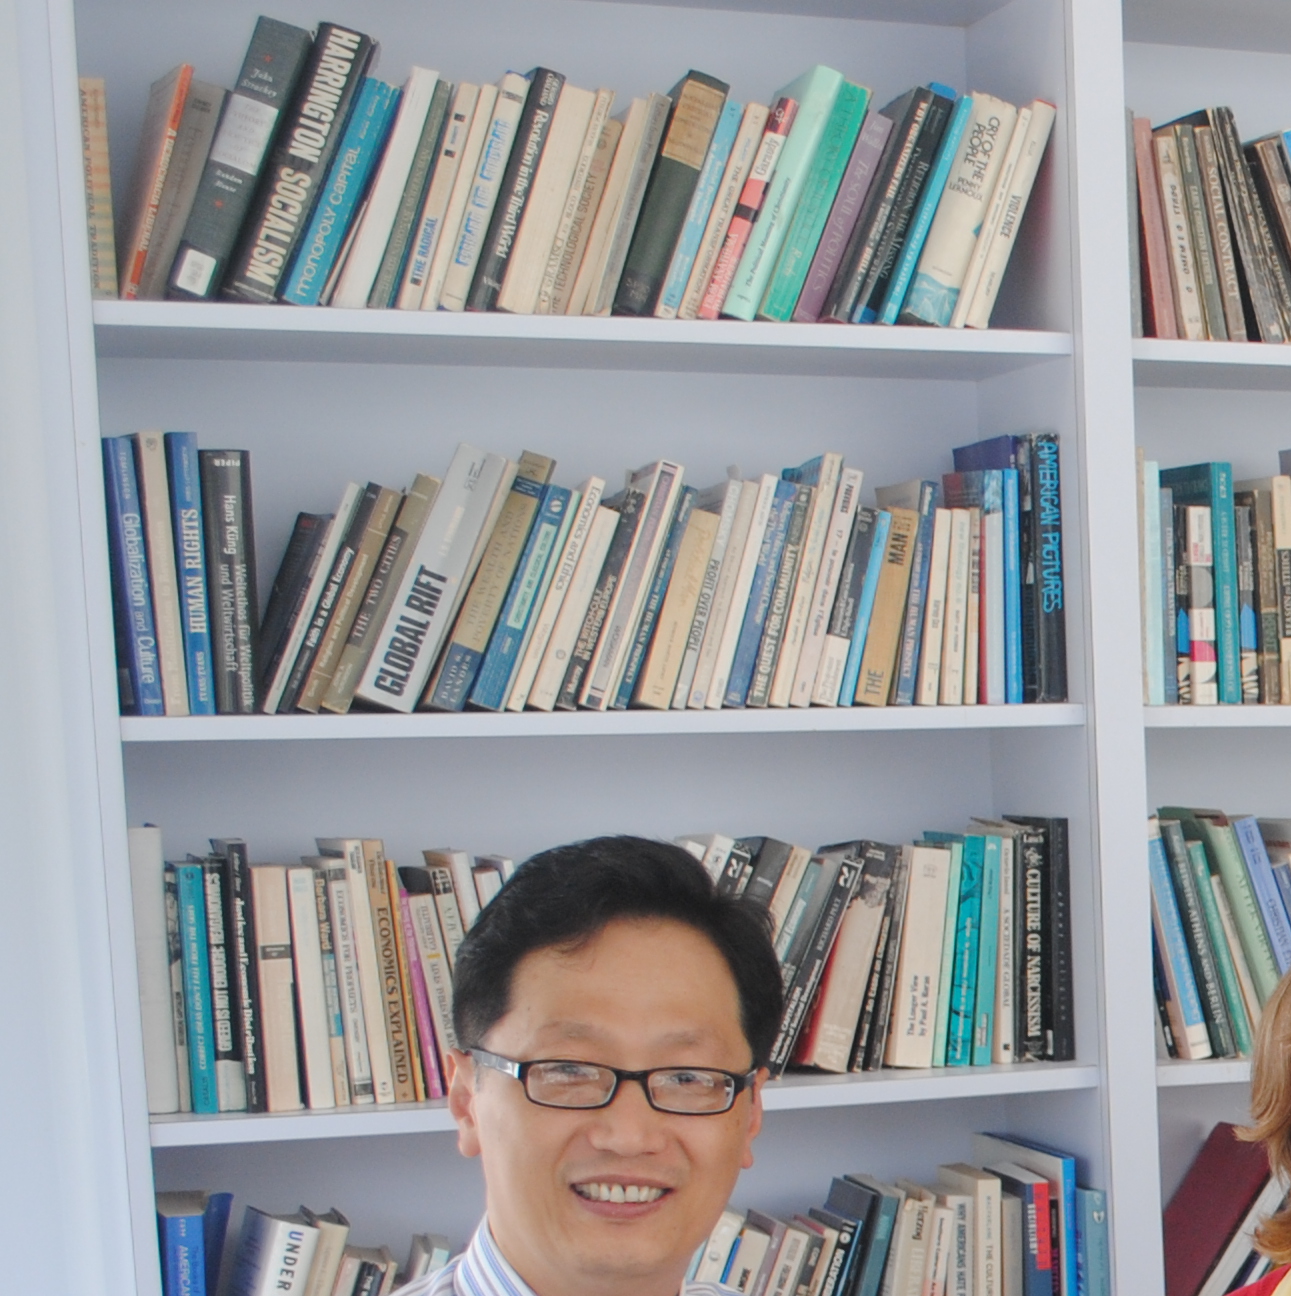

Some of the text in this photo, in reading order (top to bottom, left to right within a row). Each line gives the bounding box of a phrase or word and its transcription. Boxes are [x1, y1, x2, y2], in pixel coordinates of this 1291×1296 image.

[286, 26, 361, 163] HARRINGTON
[852, 159, 870, 180] The
[963, 121, 985, 166] PEOPLE
[972, 116, 1001, 181] CRY OF THE
[494, 109, 550, 258] Revolution in the Third World
[839, 180, 862, 216] SOUL
[245, 168, 307, 284] SOCIALISM
[412, 216, 437, 278] THE RADICAL
[1000, 193, 1022, 238] VIOLENCE
[1206, 165, 1239, 300] SOCIAL CONTRACT
[810, 230, 844, 293] POLITICS
[222, 494, 240, 555] Hans Küng
[555, 485, 600, 592] Economics and Ethics
[887, 532, 908, 565] MAN
[1036, 442, 1064, 613] AMERICAN PICTURES
[121, 512, 148, 606] Globalization
[180, 508, 206, 633] HUMAN RIGHTS
[219, 563, 233, 586] und
[134, 610, 147, 632] and
[352, 611, 371, 639] THE
[365, 580, 383, 606] TWO
[372, 610, 430, 697] GLOBAL
[404, 563, 449, 616] RIFT
[752, 543, 798, 697] THE QUEST FOR COMMUNITY
[136, 634, 158, 684] Culture
[315, 878, 331, 950] Barbara Ward
[1024, 869, 1045, 1036] CULTURE OF NARCISSISM
[377, 907, 408, 1083] ECONOMICS EXPLAINED
[905, 975, 919, 1035] The Longer View
[956, 1203, 965, 1220] WHY
[271, 1228, 310, 1292] UNDER
[955, 1223, 966, 1269] AMERICANS
[956, 1271, 966, 1290] HATE
